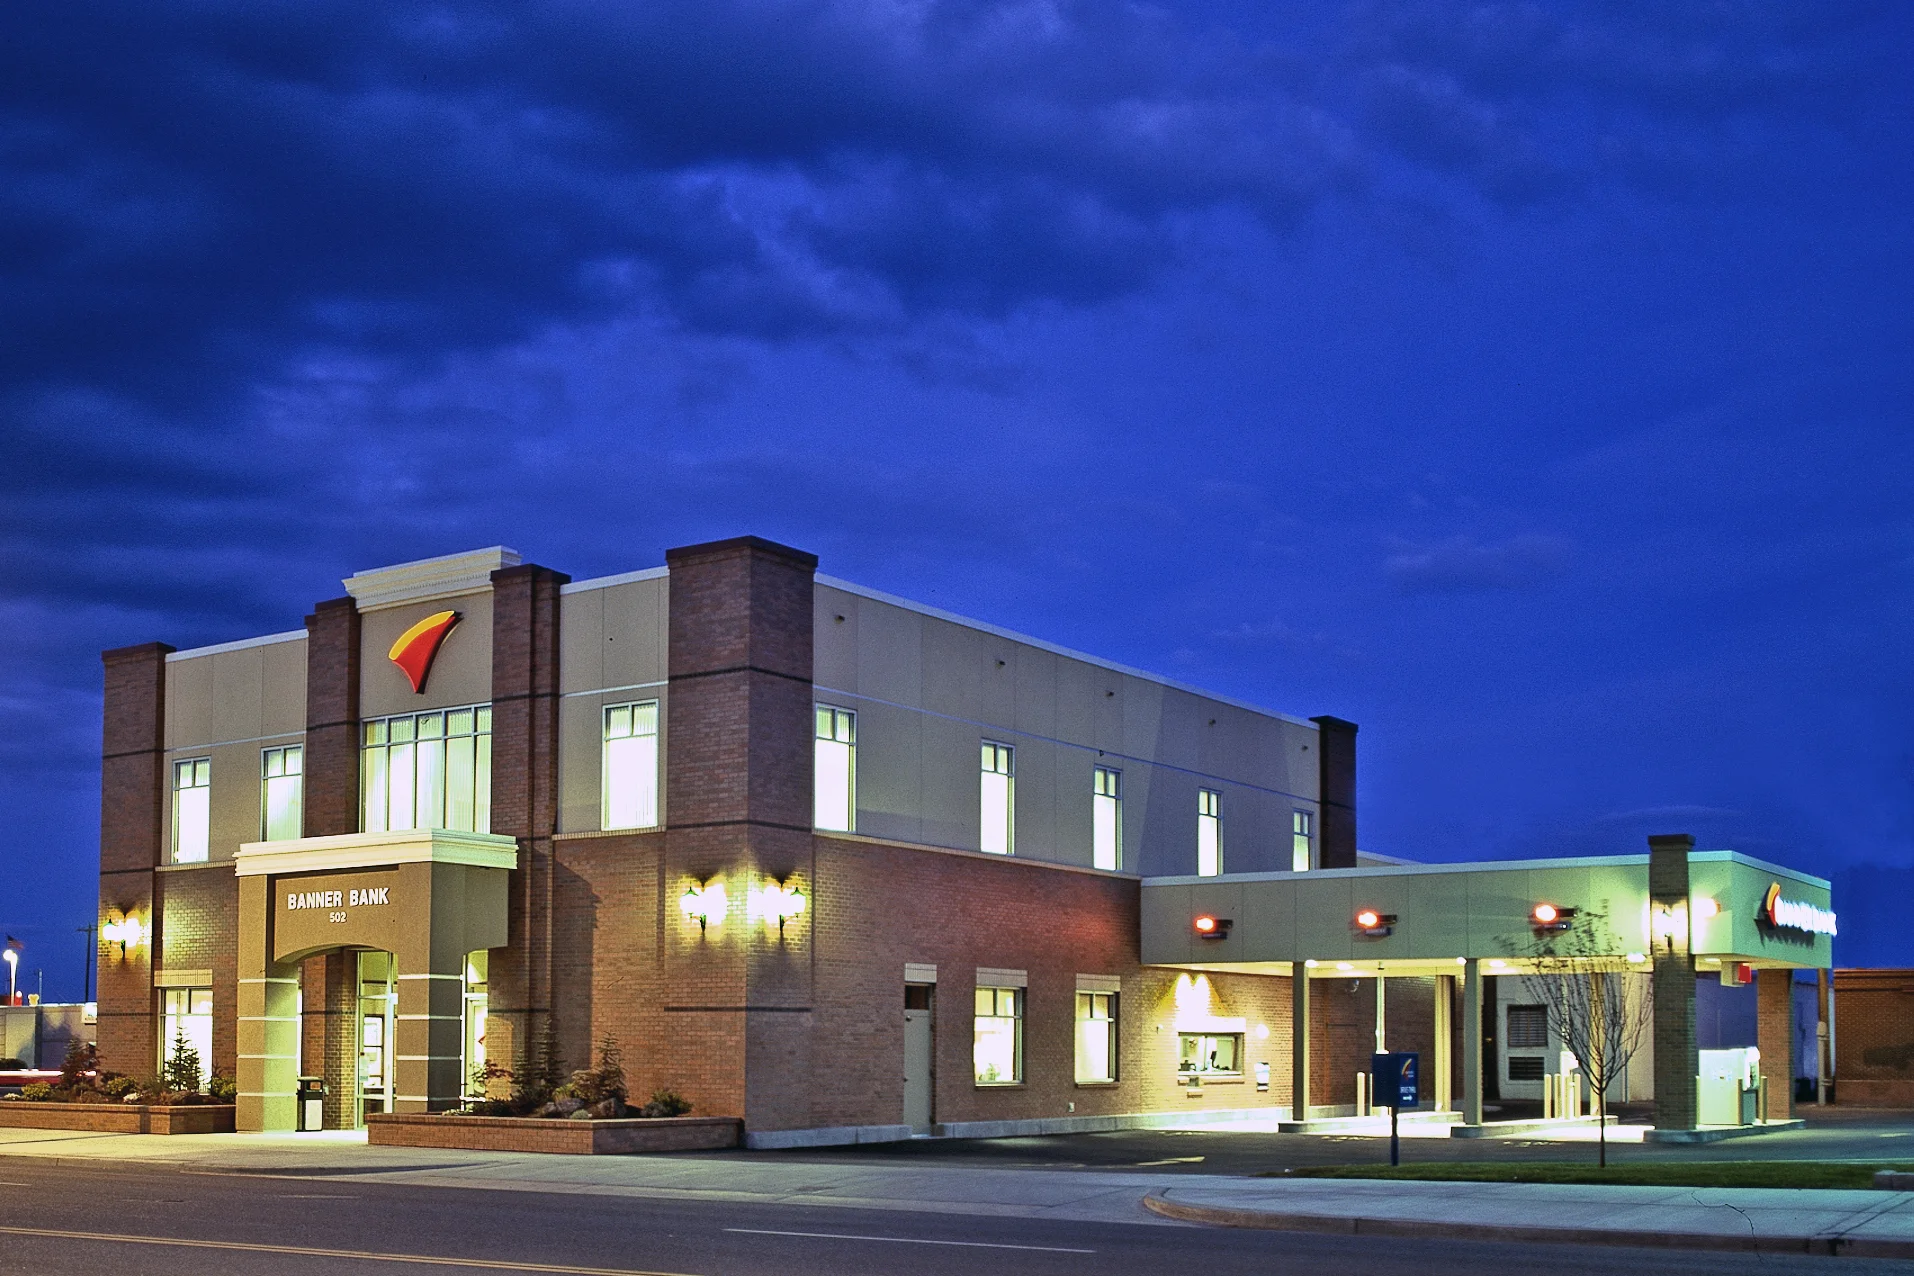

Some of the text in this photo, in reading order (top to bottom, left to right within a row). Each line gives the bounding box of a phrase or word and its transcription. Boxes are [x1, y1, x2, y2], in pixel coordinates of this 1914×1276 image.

[287, 887, 390, 910] BANNER BANK
[329, 911, 347, 923] 502
